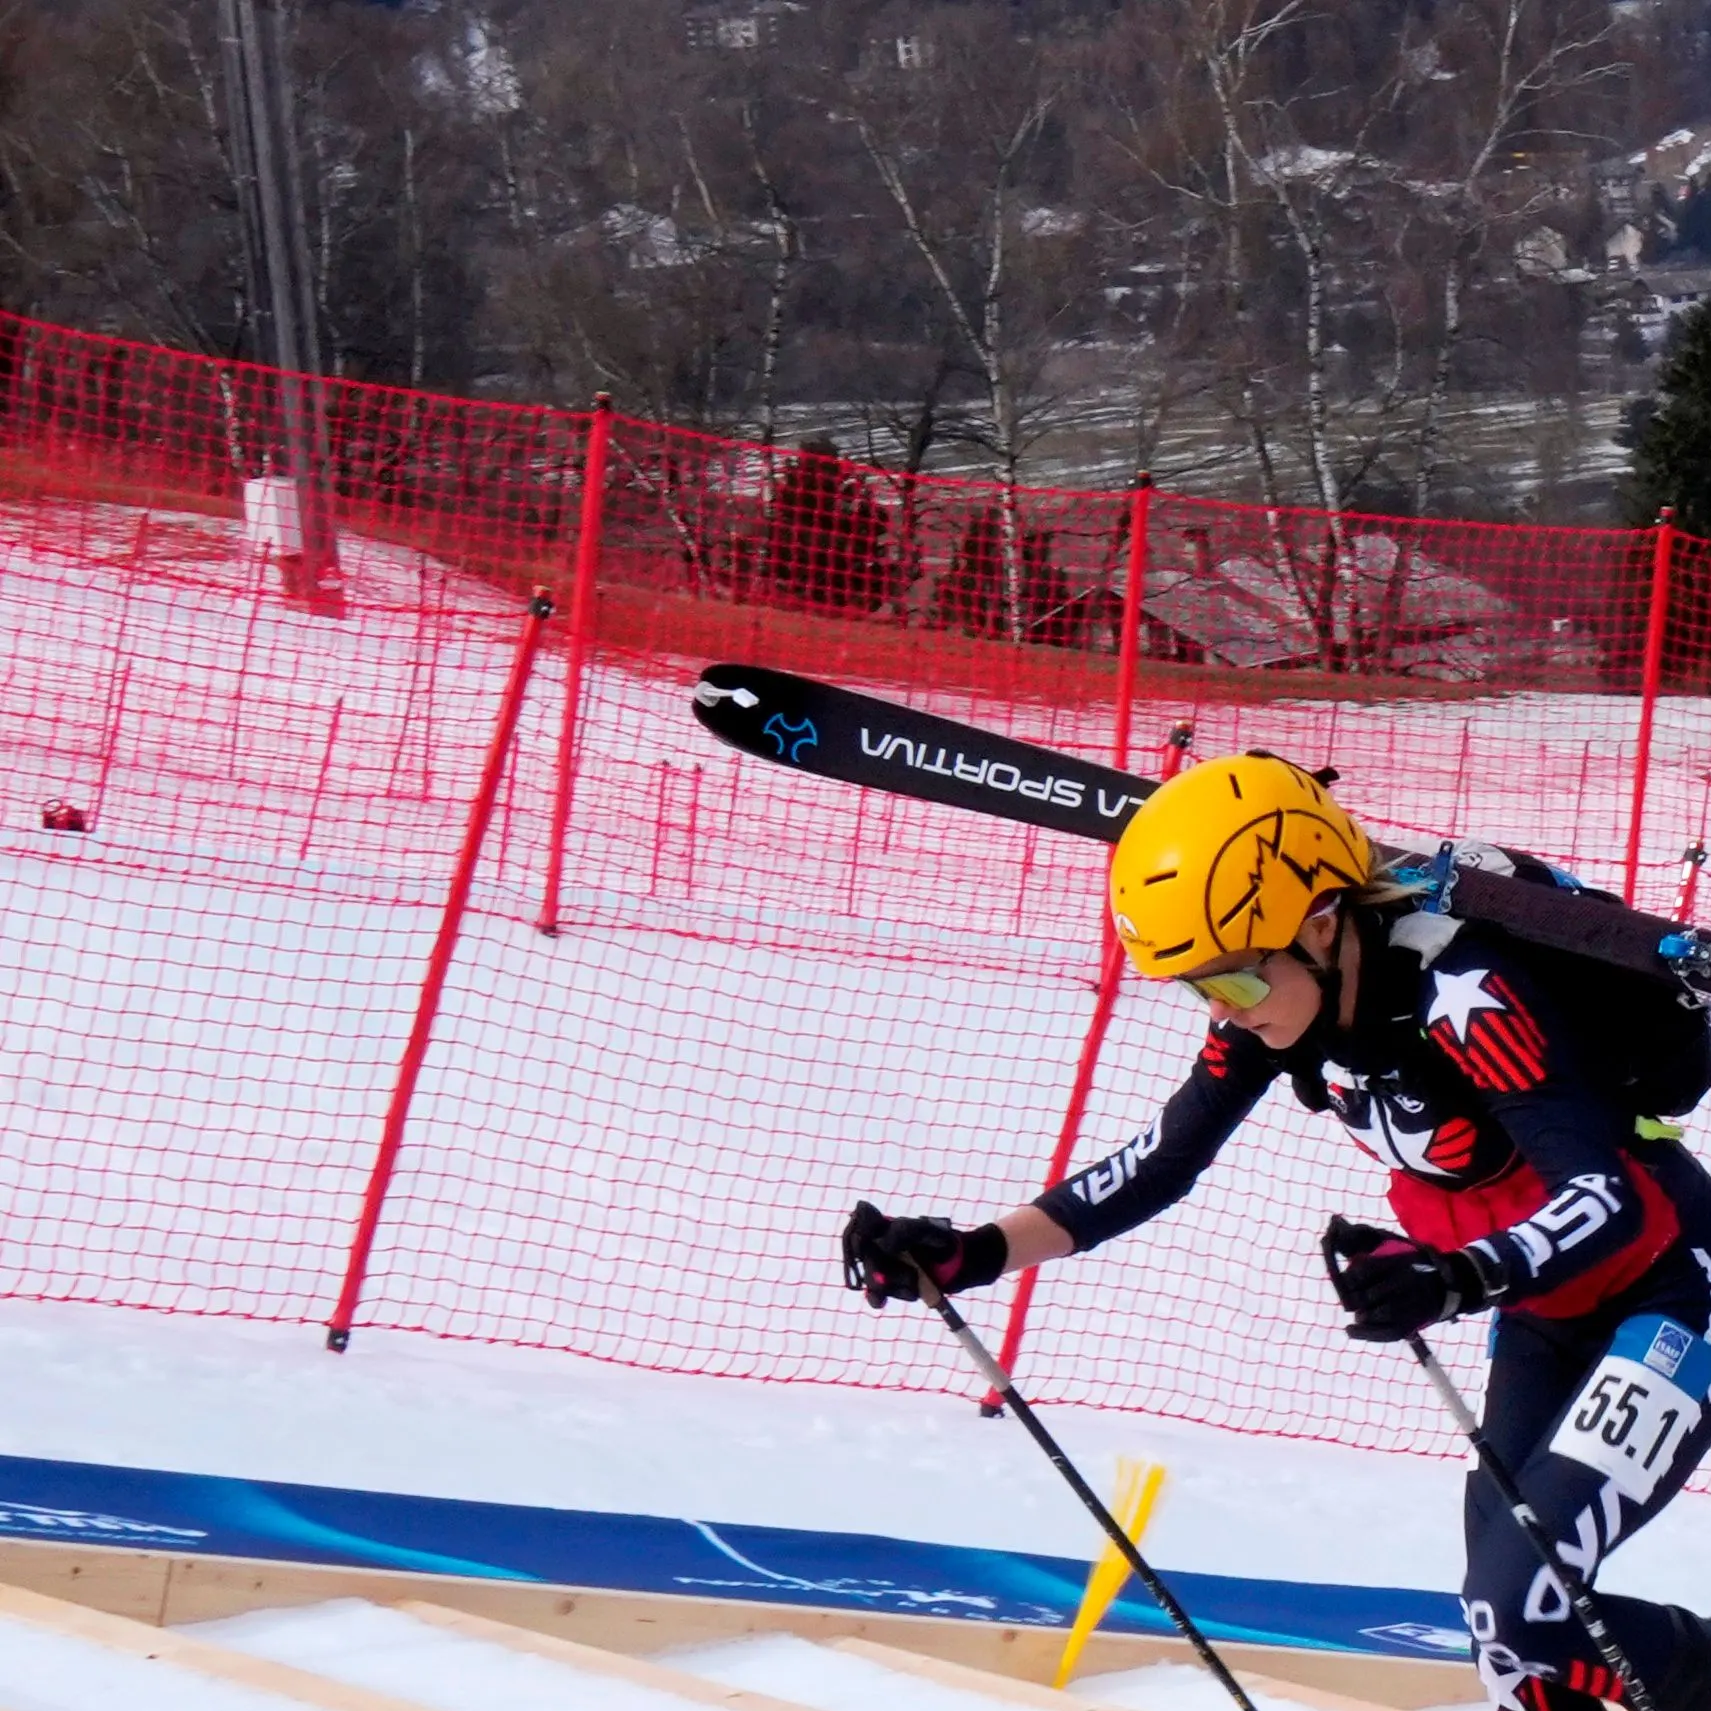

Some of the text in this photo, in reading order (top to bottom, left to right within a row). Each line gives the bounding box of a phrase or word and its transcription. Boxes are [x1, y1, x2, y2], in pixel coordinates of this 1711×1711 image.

[860, 727, 1086, 808] SPORTIVA
[1507, 1173, 1623, 1278] USA
[1574, 1374, 1680, 1471] 55.1
